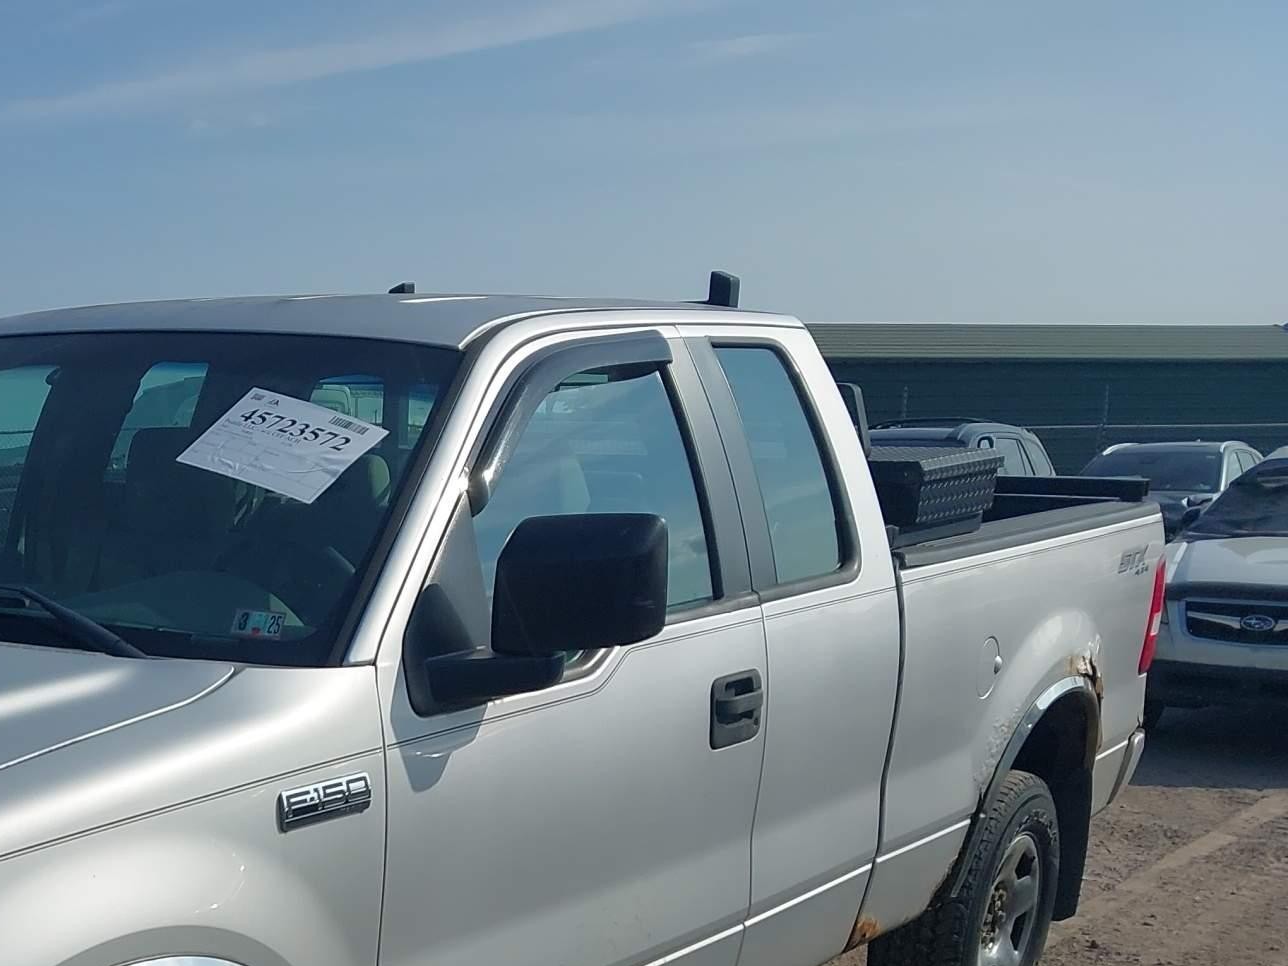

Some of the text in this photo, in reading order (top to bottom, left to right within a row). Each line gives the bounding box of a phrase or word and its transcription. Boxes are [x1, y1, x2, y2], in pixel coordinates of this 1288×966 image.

[240, 408, 351, 451] 45723572
[267, 615, 282, 634] 25
[284, 776, 372, 818] F-150
